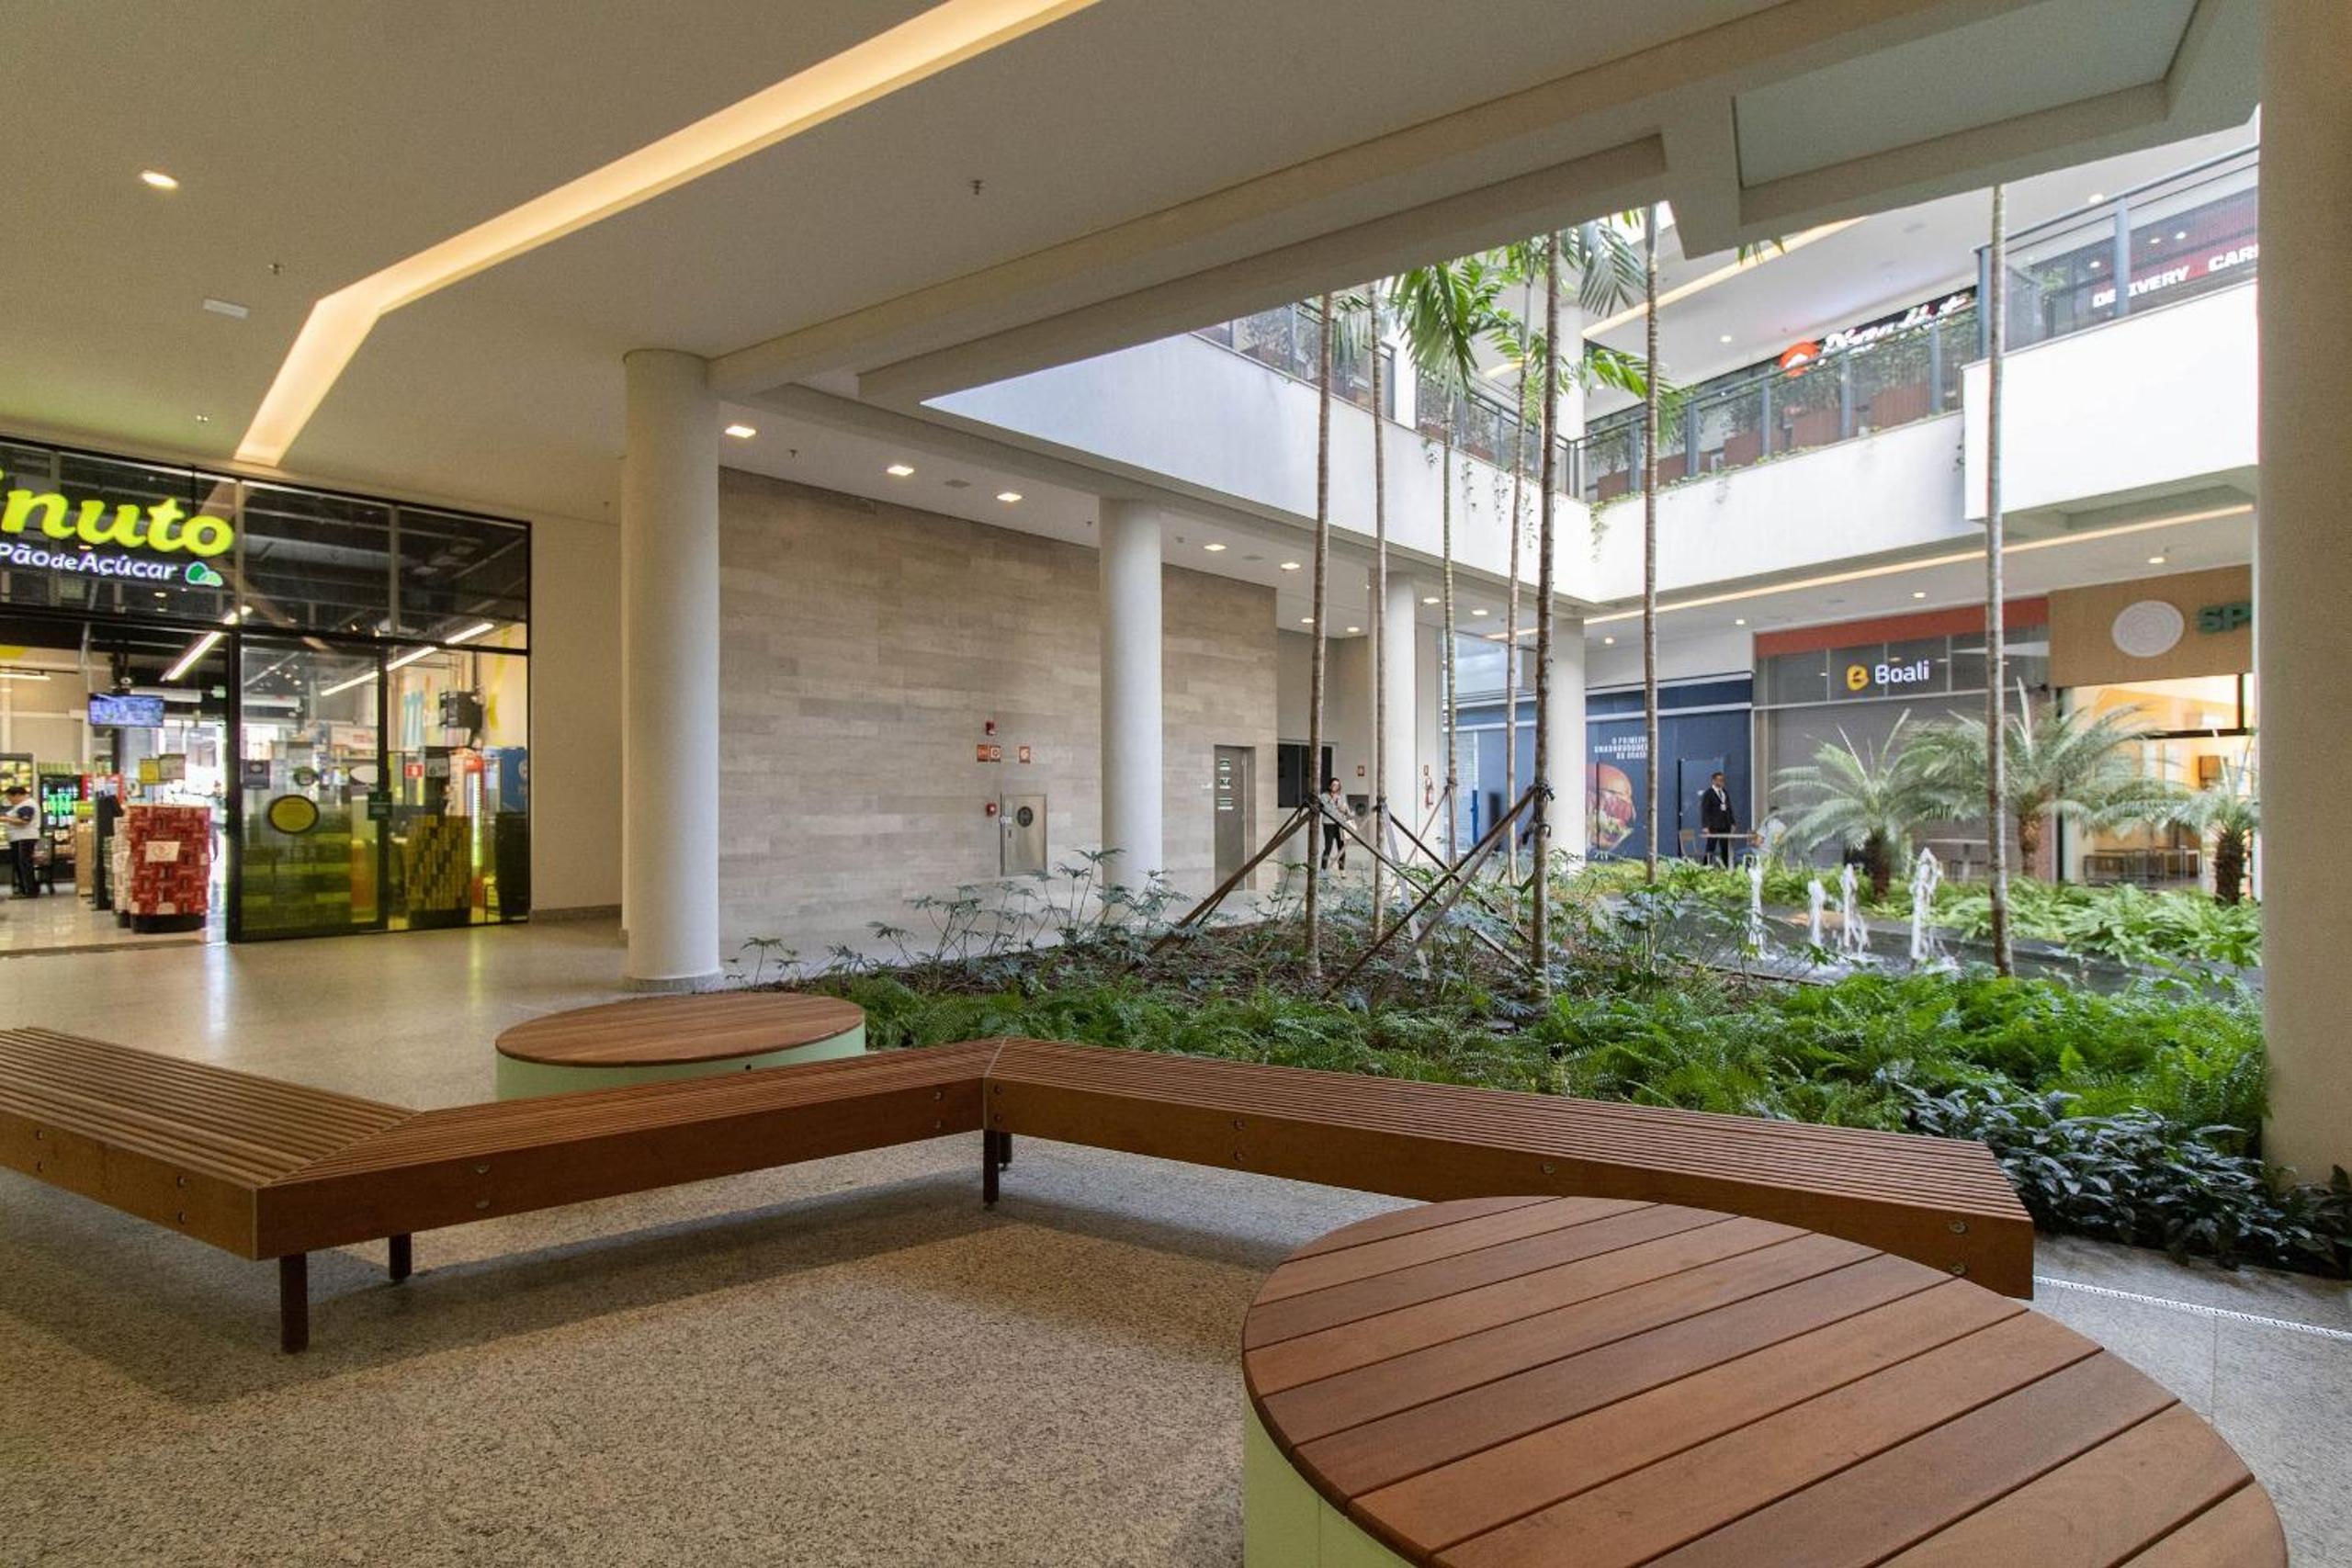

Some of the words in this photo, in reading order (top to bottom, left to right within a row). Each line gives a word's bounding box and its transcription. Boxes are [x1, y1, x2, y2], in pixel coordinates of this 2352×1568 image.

[2092, 265, 2189, 308] DEIVERY
[0, 478, 234, 558] nuto
[1874, 660, 1929, 684] Boali
